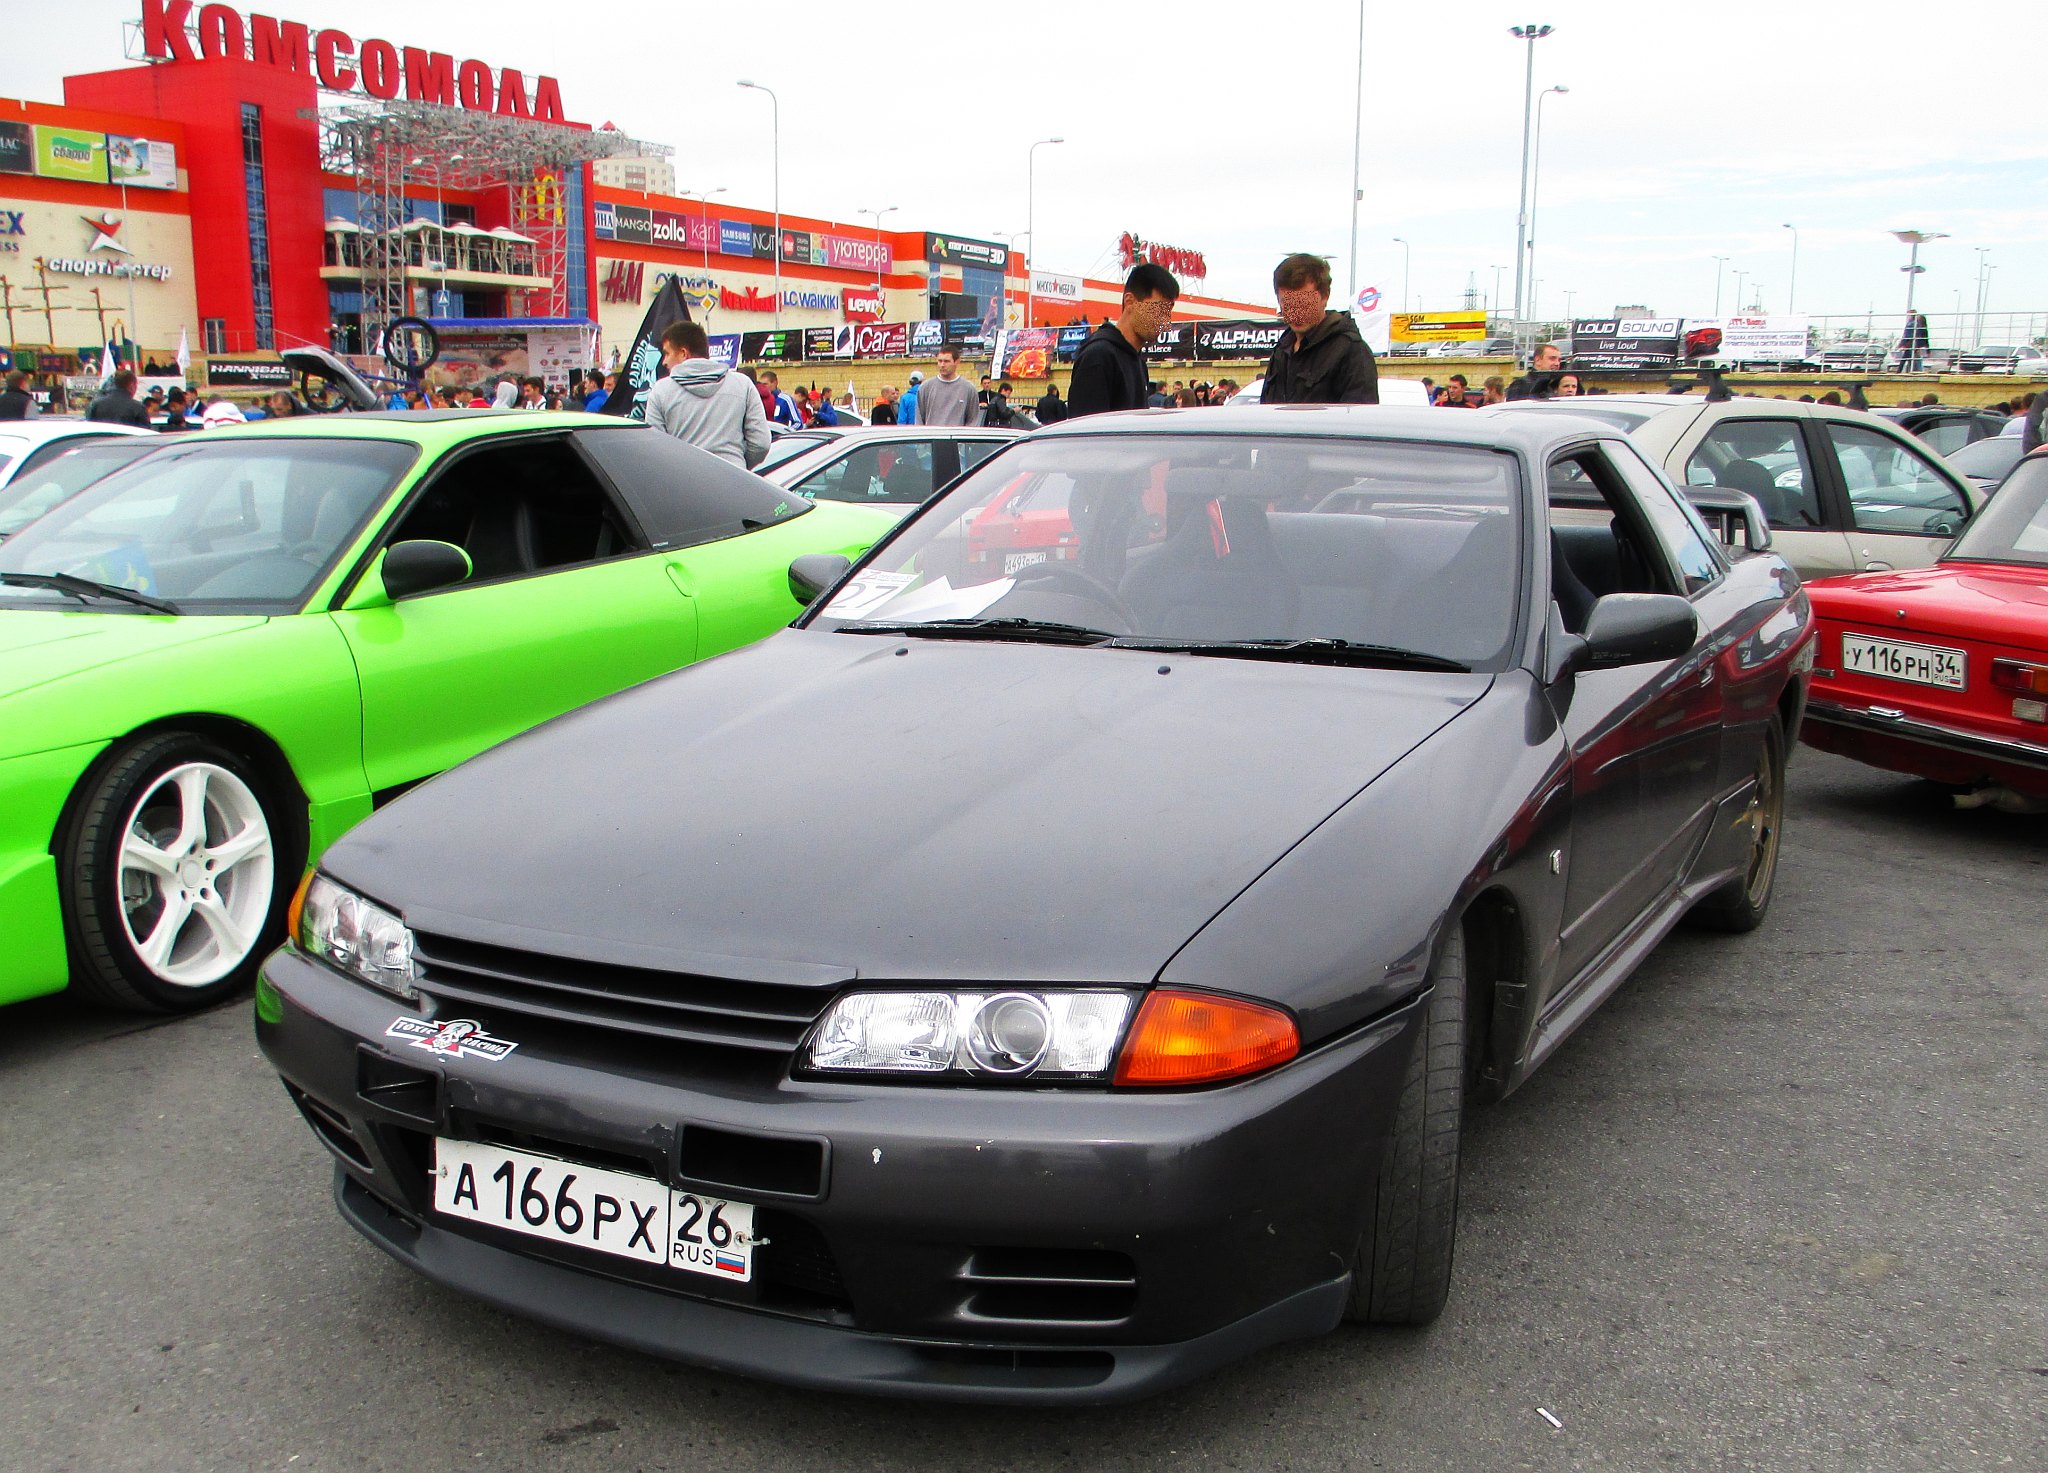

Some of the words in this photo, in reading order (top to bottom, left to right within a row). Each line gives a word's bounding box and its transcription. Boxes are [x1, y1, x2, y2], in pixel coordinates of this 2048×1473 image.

[616, 218, 650, 231] MANGO
[653, 218, 686, 242] zolla
[691, 218, 716, 242] kari
[722, 228, 750, 241] SAMSUNG
[989, 248, 1006, 265] 3D
[602, 259, 645, 306] H&M
[783, 290, 799, 306] LC
[1410, 315, 1425, 323] SGM
[1576, 323, 1616, 334] LOUD
[1621, 323, 1674, 333] SOUND
[855, 326, 890, 352] iCar
[912, 336, 943, 346] STUDIO
[1599, 340, 1615, 350] Live
[1617, 340, 1639, 350] Loud
[210, 364, 290, 374] HANNIBAL
[1935, 654, 1956, 676] 34
[1934, 673, 1949, 683] RUS
[395, 1021, 437, 1035] TOXIC
[460, 1037, 507, 1053] RACING
[677, 1194, 733, 1248] 26
[672, 1242, 714, 1266] RUS
